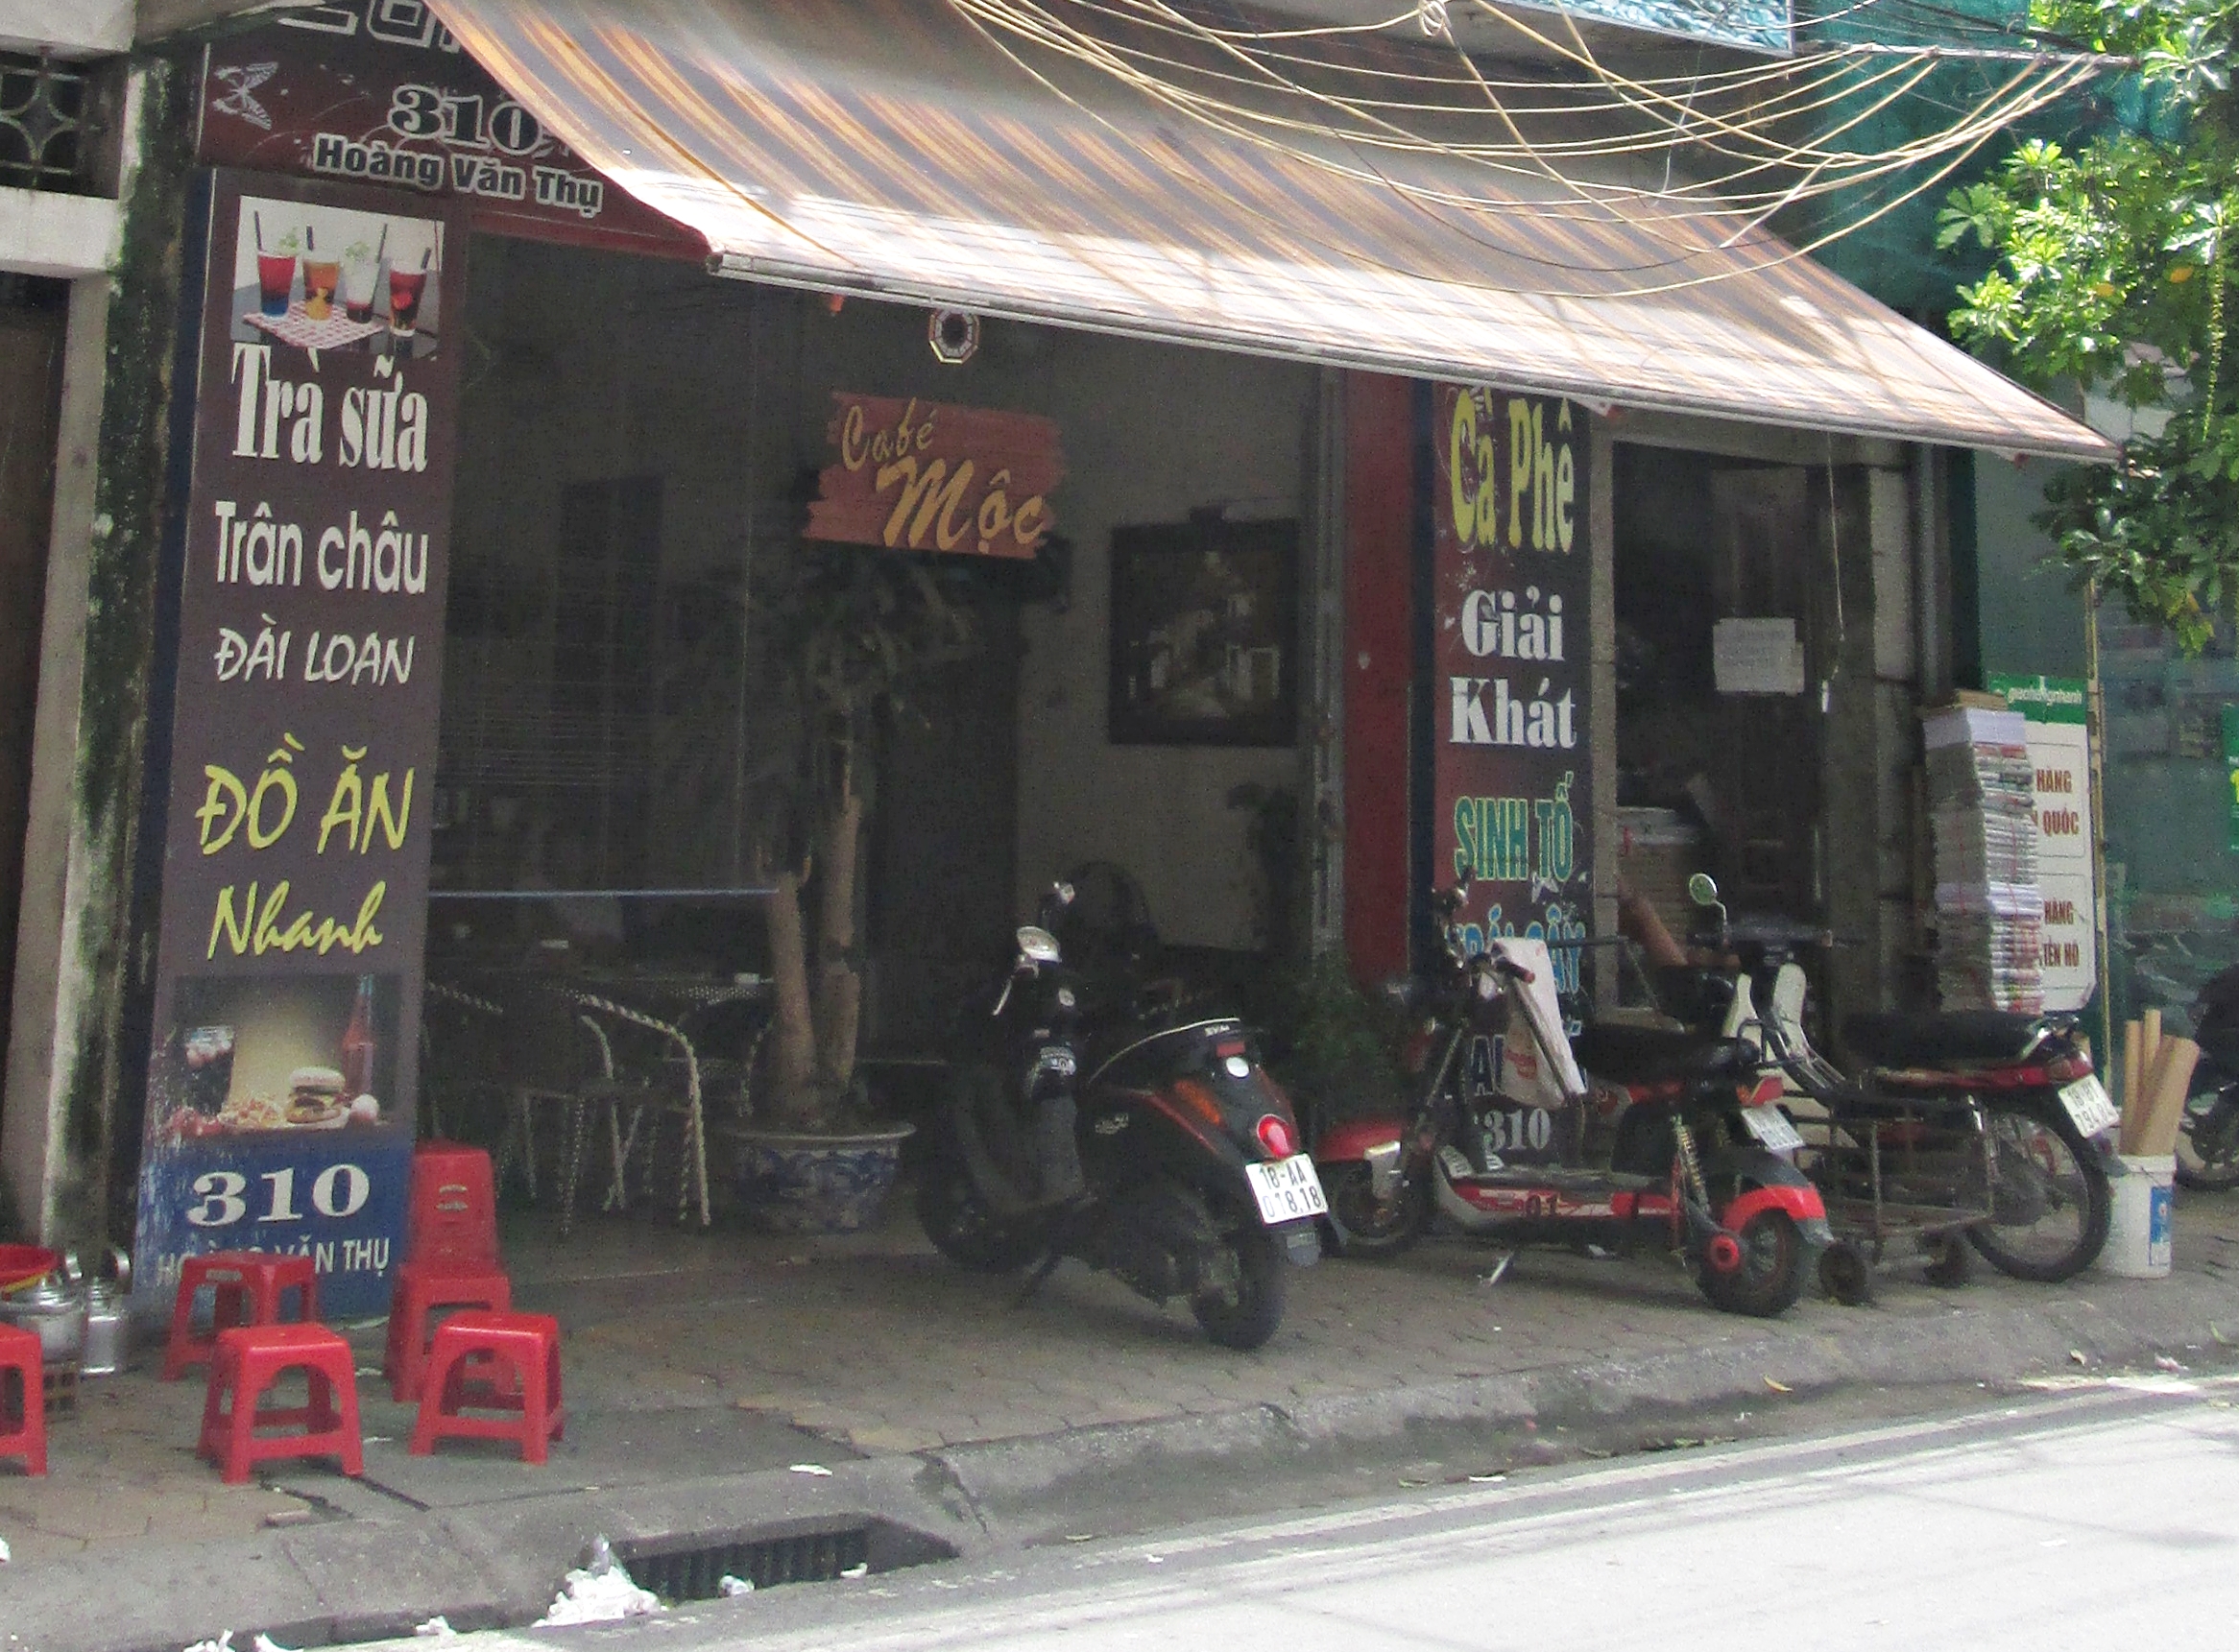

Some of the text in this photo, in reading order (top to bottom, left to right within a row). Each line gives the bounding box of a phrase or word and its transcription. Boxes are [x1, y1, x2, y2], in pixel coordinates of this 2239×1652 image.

[387, 83, 543, 156] 310
[313, 132, 604, 219] Hoàng Văn Thụ
[230, 342, 428, 472] Trà sữa
[876, 455, 1045, 554] Mộc
[1451, 387, 1576, 555] Cà Phê
[215, 500, 429, 594] Trân châu
[214, 612, 415, 686] ĐÀI LOAN
[1461, 586, 1565, 662] Giải
[1450, 676, 1577, 750] Khát
[195, 731, 415, 855] ĐỒ ĂN
[1454, 770, 1574, 882] SINH TỐ
[207, 880, 386, 960] Nhanh
[1482, 1108, 1551, 1153] 310
[187, 1163, 370, 1227] 310
[1260, 1161, 1308, 1189] 18-AA
[343, 1237, 390, 1277] THỤ
